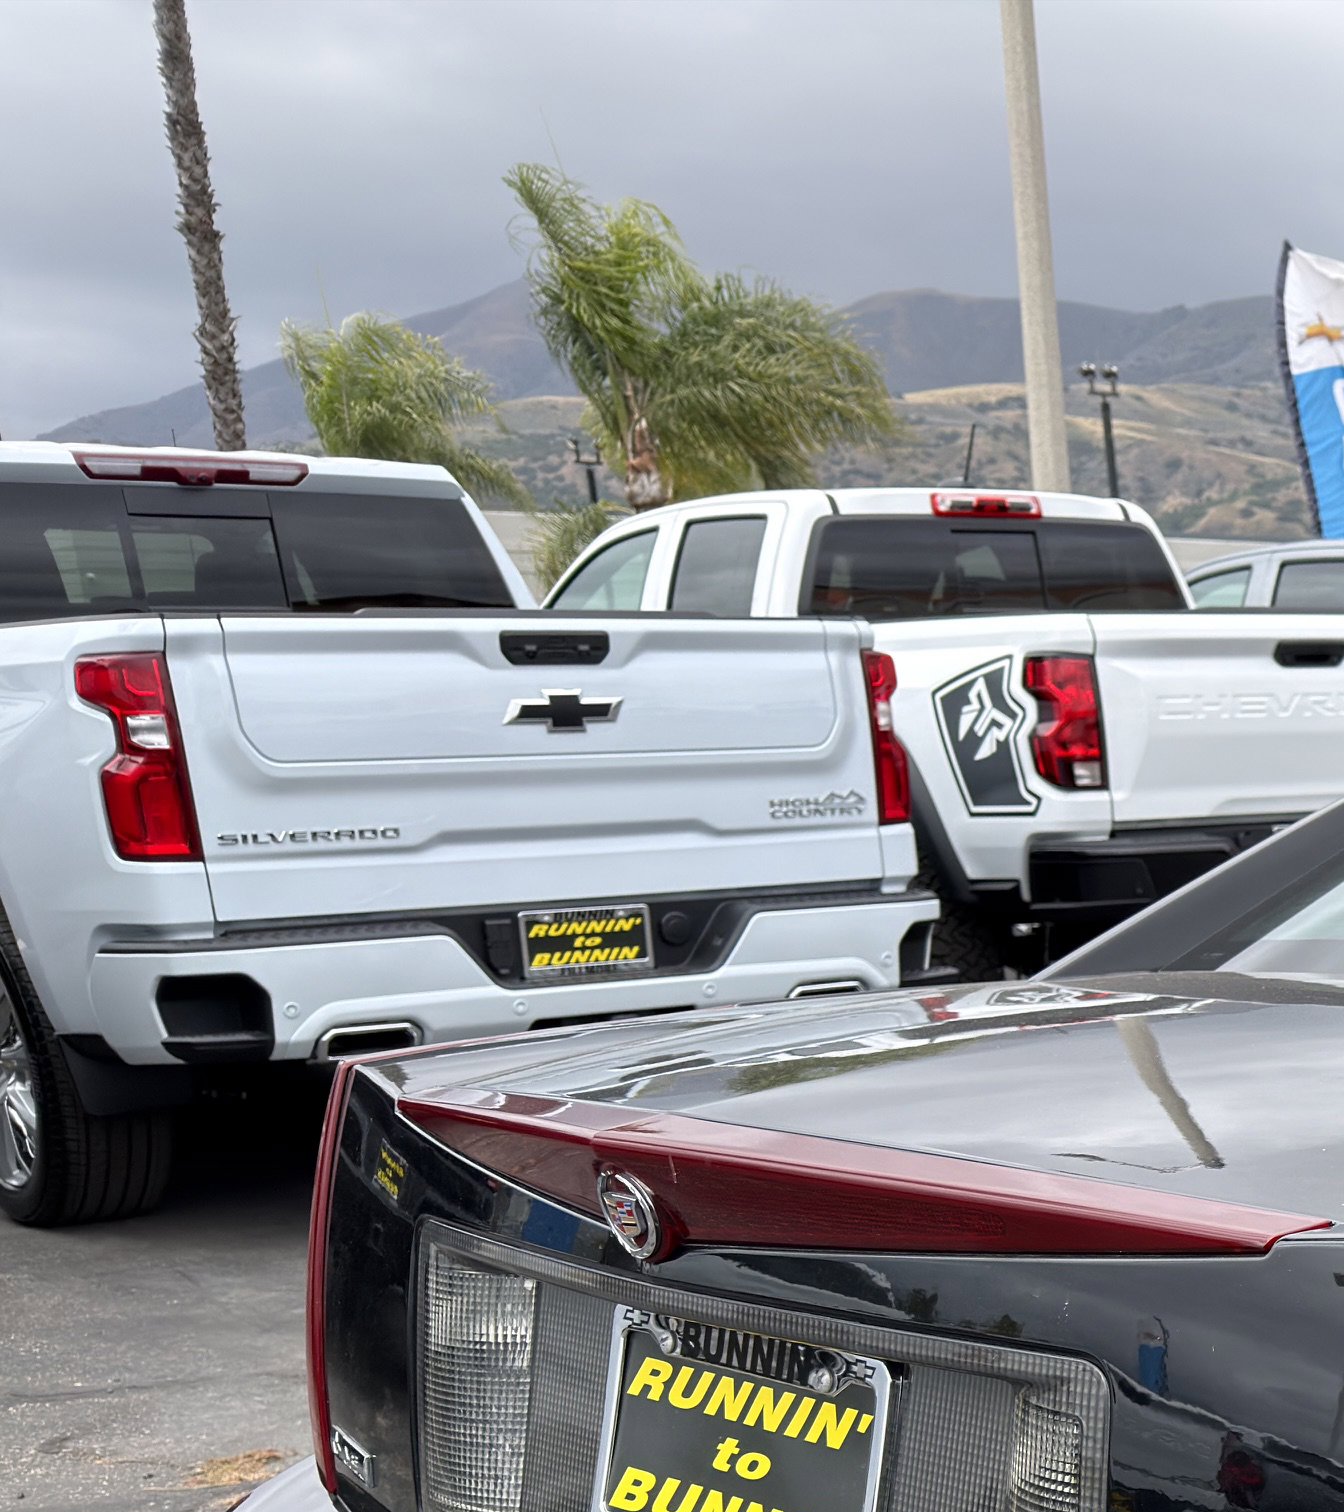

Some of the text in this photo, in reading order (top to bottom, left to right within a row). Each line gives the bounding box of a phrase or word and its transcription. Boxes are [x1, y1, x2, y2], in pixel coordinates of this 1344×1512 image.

[769, 798, 822, 809] HIGH
[770, 807, 863, 819] COUNTRY
[217, 827, 400, 846] SILVERADO
[528, 917, 642, 938] RUNNIN'
[574, 936, 602, 947] to
[531, 945, 640, 966] BUNNIN
[679, 1320, 812, 1387] BUNNIN
[627, 1356, 874, 1450] RUNNIN'
[712, 1437, 771, 1480] to
